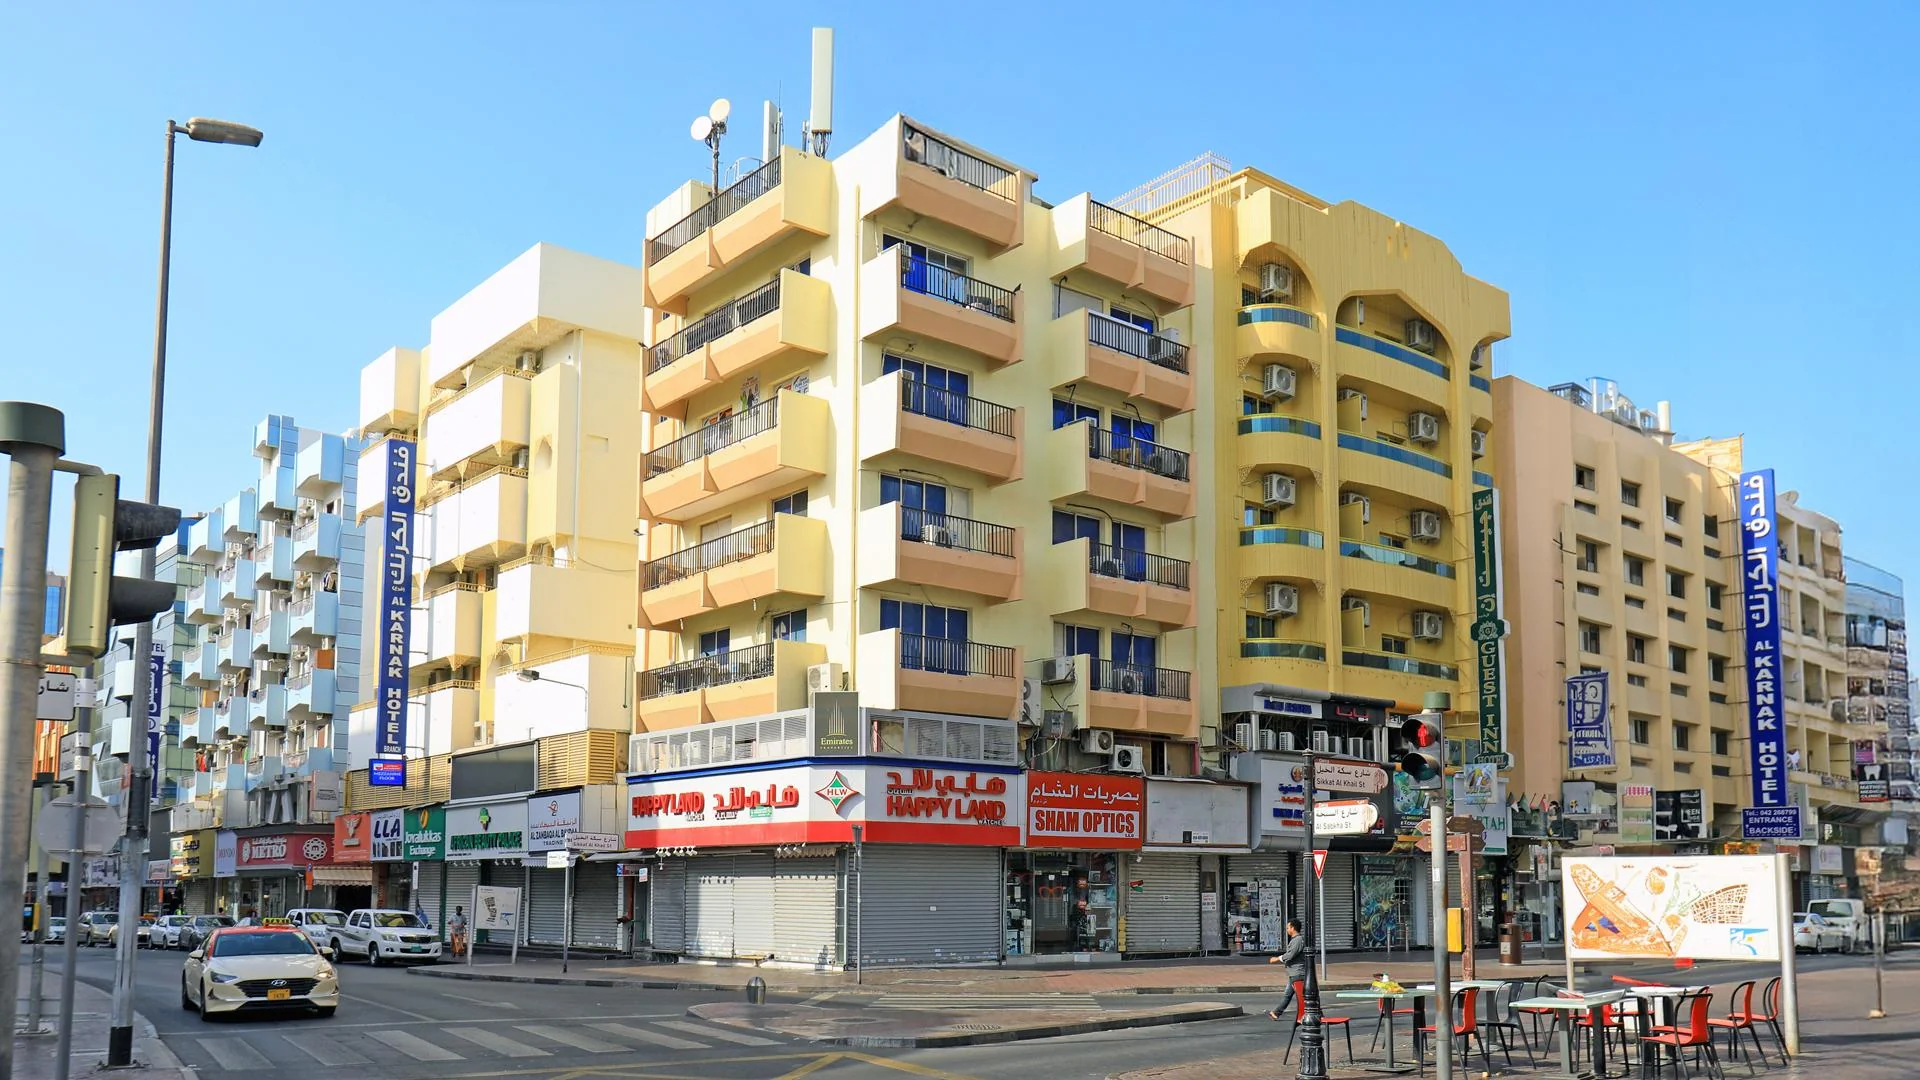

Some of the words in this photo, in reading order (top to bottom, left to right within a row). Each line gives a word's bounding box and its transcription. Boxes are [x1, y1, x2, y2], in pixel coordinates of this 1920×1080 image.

[392, 446, 411, 503] فندق
[1744, 474, 1771, 538] فندق
[389, 511, 410, 585] الكرنك
[1747, 546, 1773, 628] الكرنك
[391, 596, 406, 606] AL
[151, 643, 166, 653] TEL
[387, 610, 405, 679] KARNAK
[1754, 640, 1774, 651] AL
[1480, 641, 1497, 707] GUEST
[38, 680, 70, 695] شار
[1754, 655, 1777, 730] KARNAK
[386, 688, 402, 744] HOTEL
[820, 737, 853, 745] Emirates
[1482, 714, 1499, 754] INN
[383, 745, 402, 753] BRANCH
[1477, 754, 1507, 766] HOTEL
[886, 768, 934, 791] لاند
[1316, 777, 1335, 786] Sikkat
[1358, 780, 1366, 788] St
[1354, 768, 1371, 778] شارع
[1758, 741, 1779, 804] HOTEL
[827, 788, 848, 796] HLW
[934, 772, 1007, 797] هابي
[1030, 780, 1079, 803] الشام
[1083, 784, 1140, 806] بصريات
[632, 794, 668, 818] HAPPY
[670, 791, 705, 815] LAND
[886, 795, 953, 818] HAPPY
[955, 798, 1007, 821] LAND
[1035, 809, 1080, 832] SHAM
[1082, 811, 1135, 834] OPTICS
[1749, 816, 1794, 824] ENTRANCE
[1749, 826, 1794, 834] BACKSIDE
[251, 844, 287, 859] METRO
